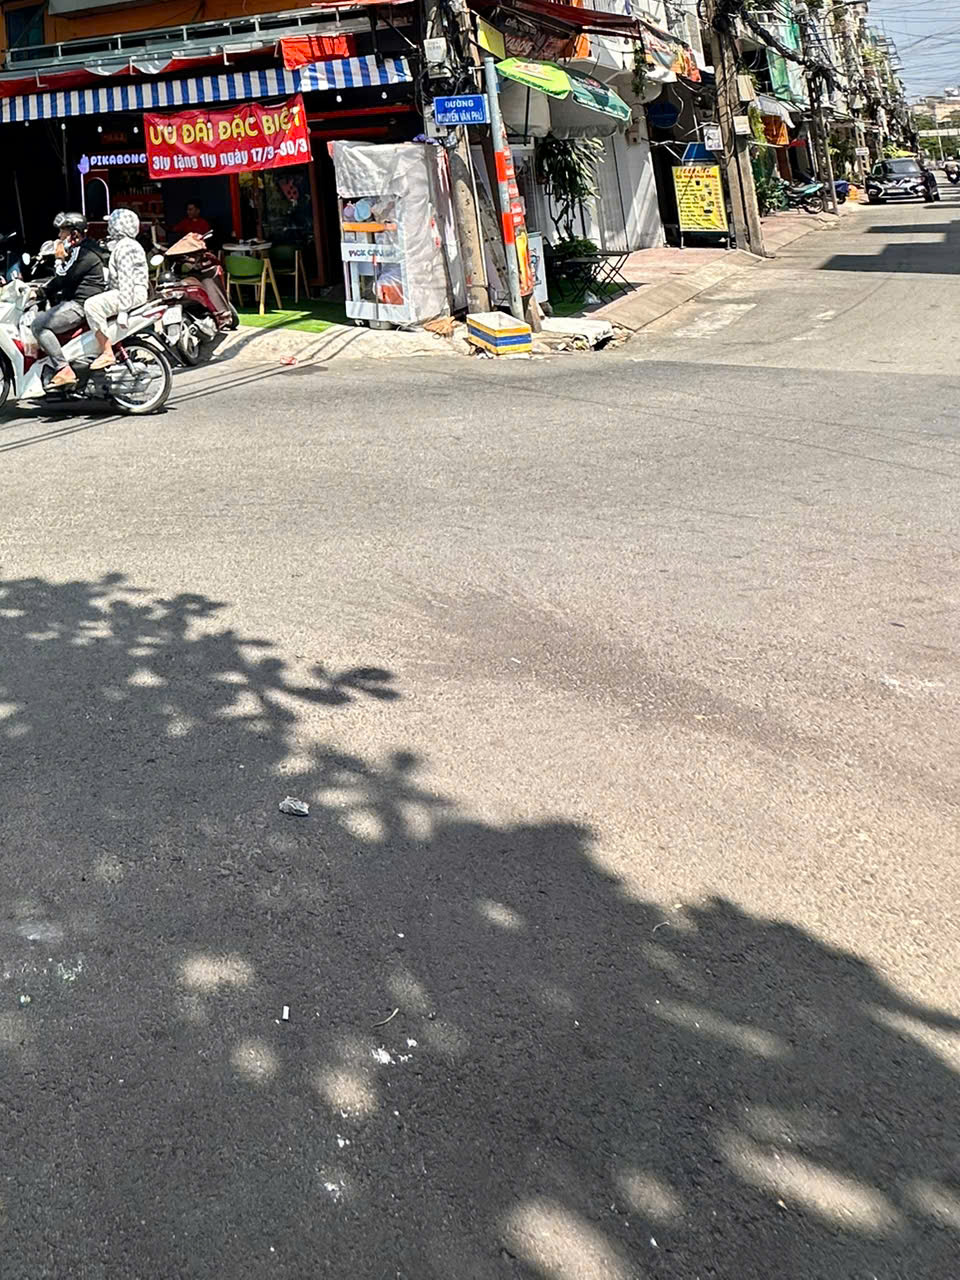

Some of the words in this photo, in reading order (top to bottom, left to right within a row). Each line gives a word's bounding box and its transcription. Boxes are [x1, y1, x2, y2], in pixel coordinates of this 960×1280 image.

[218, 113, 258, 141] ĐẶC
[90, 153, 146, 166] PIKABONG
[173, 153, 199, 172] tặng
[220, 148, 249, 167] ngày
